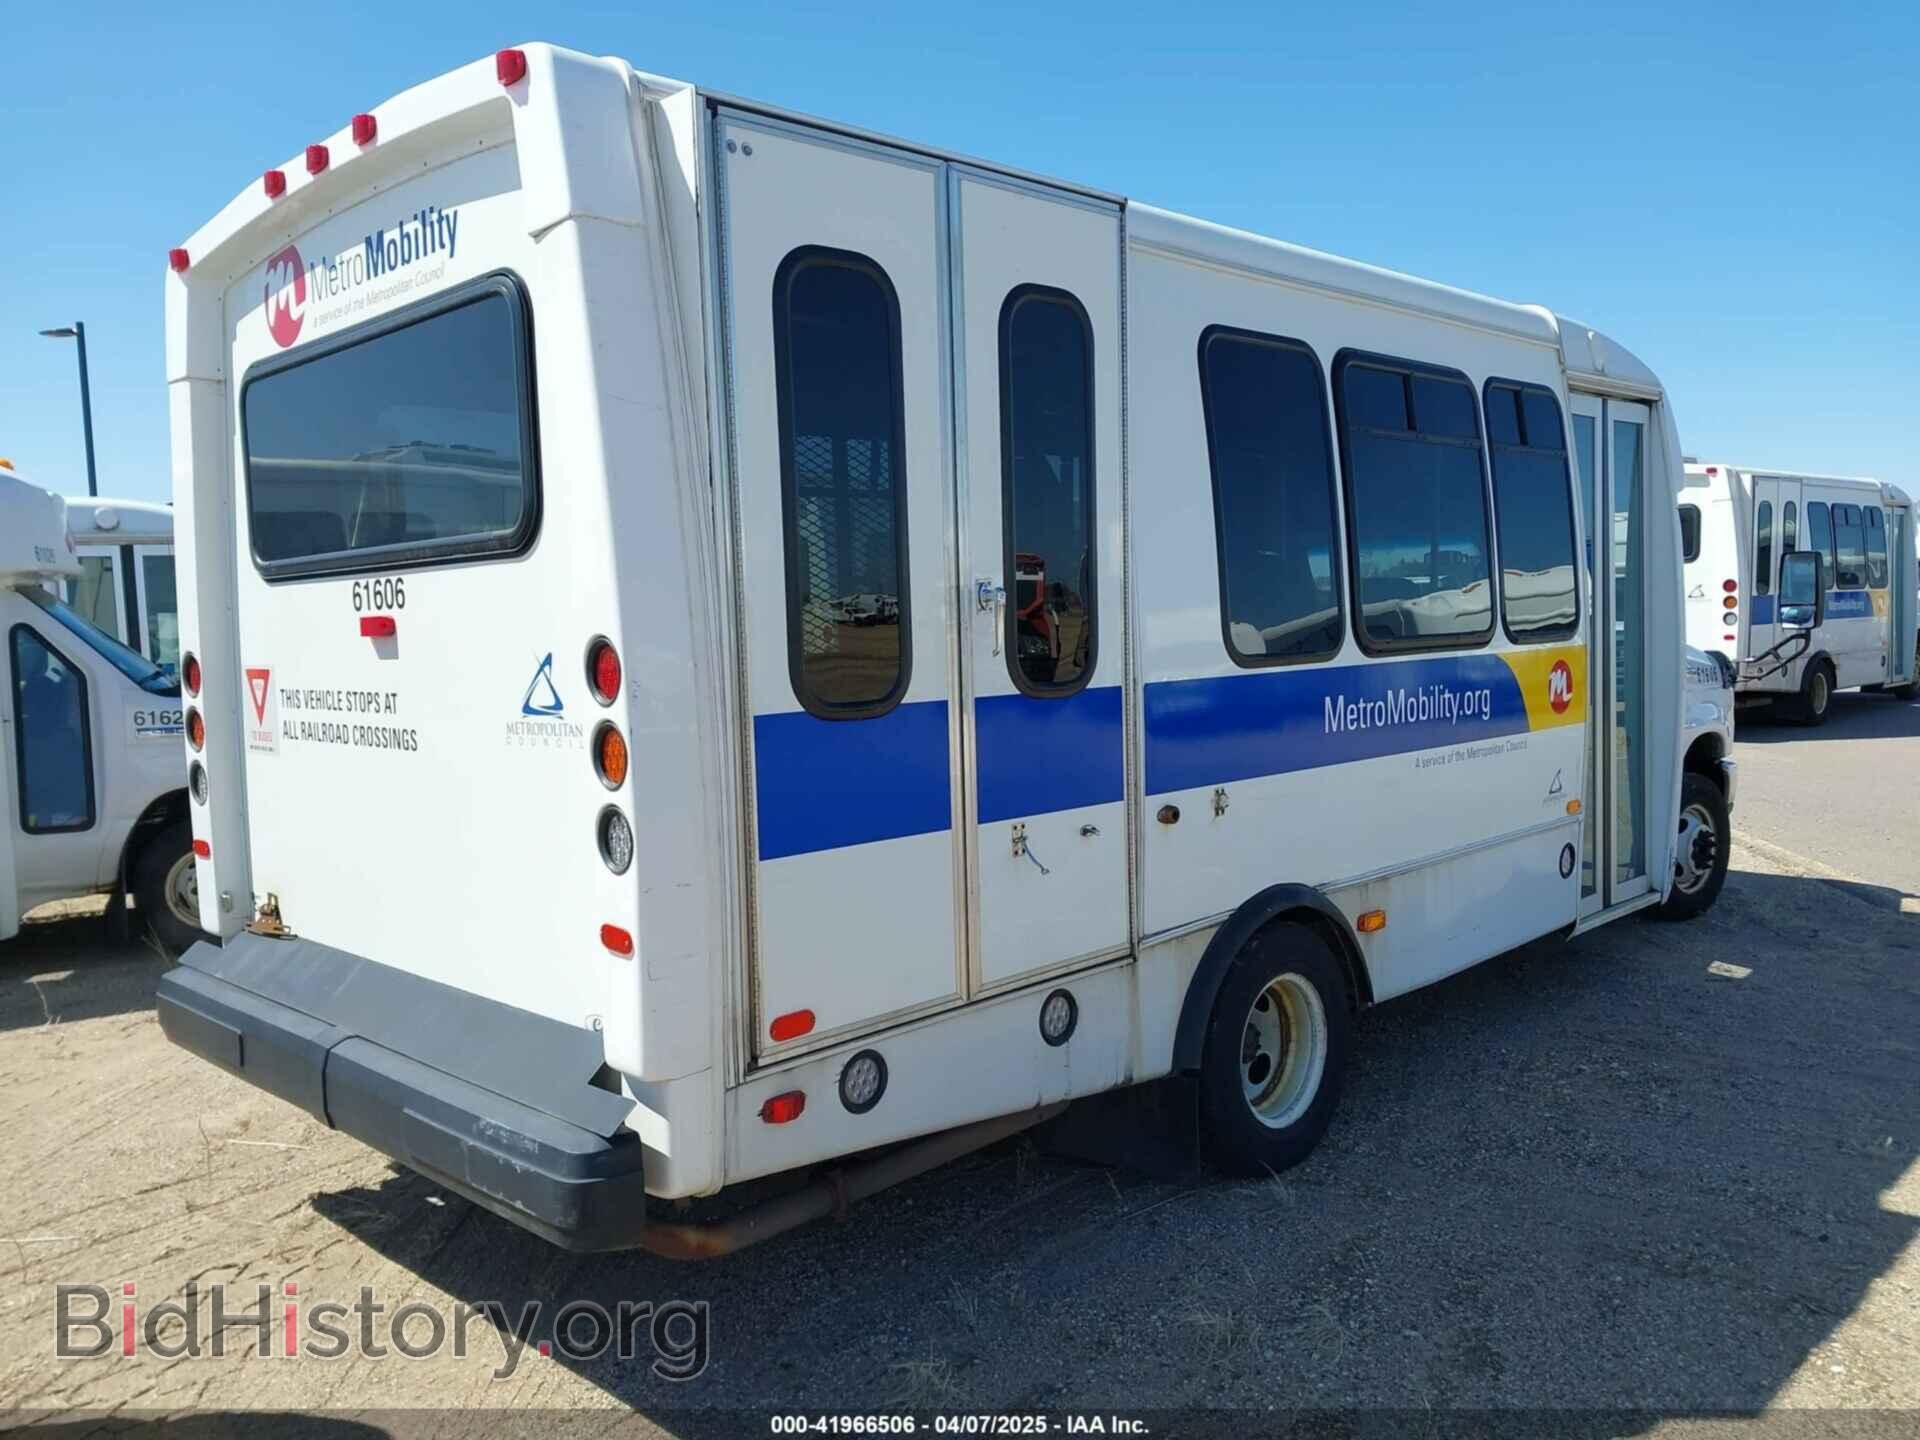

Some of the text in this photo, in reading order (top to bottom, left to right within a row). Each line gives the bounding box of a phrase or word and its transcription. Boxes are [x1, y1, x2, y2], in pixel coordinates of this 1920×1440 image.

[310, 206, 458, 304] MetroMobility
[352, 577, 406, 612] 61606
[280, 689, 397, 715] THIS VEHICLE STOPS AT
[1324, 684, 1490, 734] MetroMobility.org
[283, 720, 299, 741] ALL
[300, 721, 350, 745] RAILROAD
[352, 725, 418, 752] CROSSINGS
[505, 735, 585, 749] COUNCIL
[506, 721, 583, 737] METROPOLITAN
[1422, 754, 1446, 768] service
